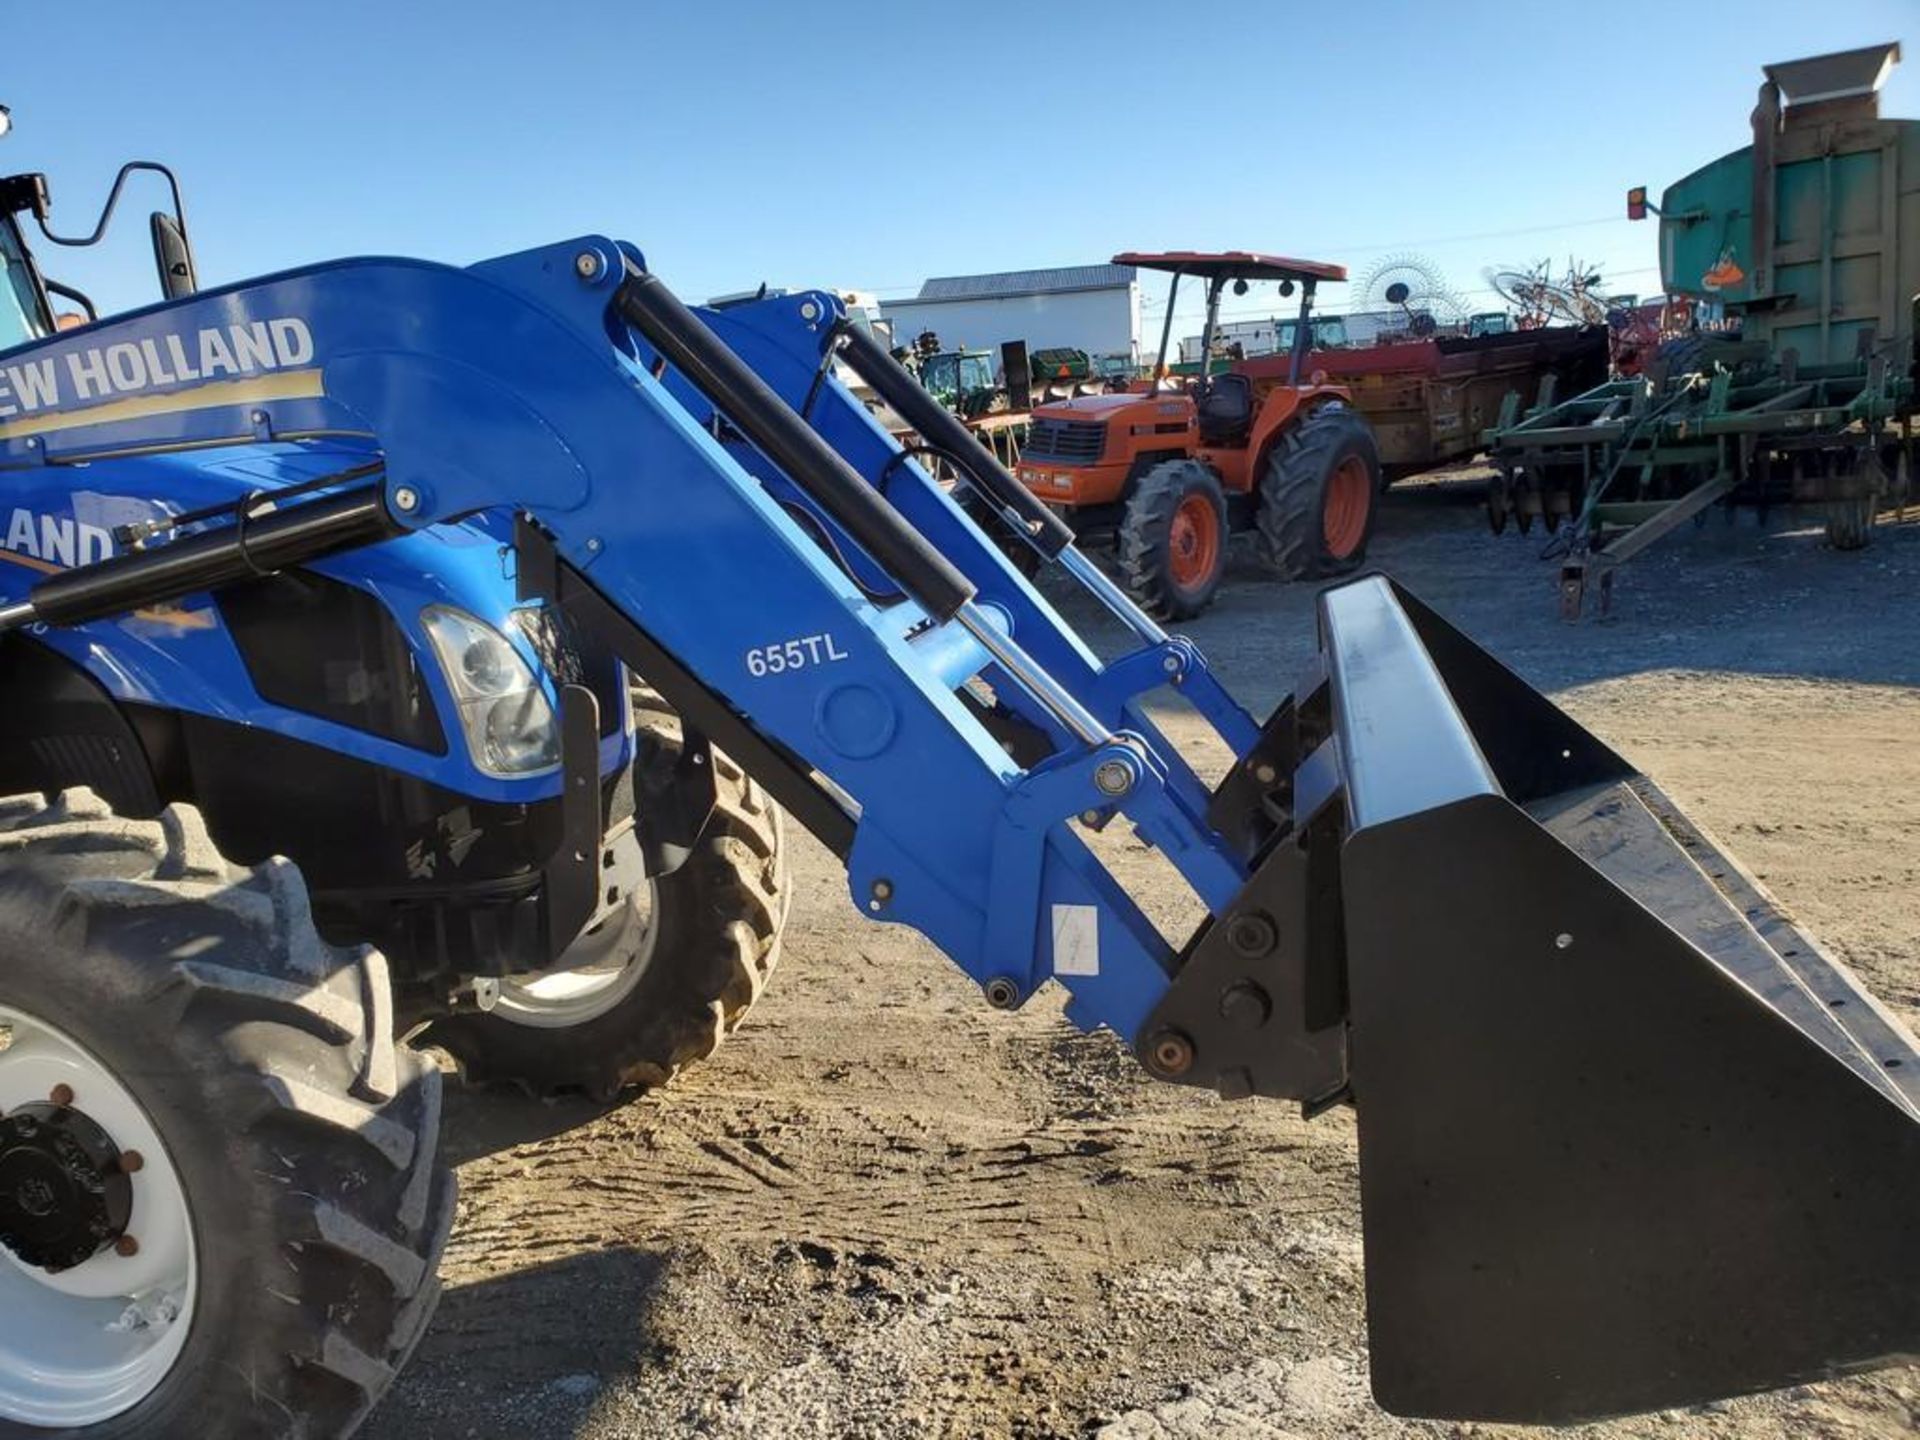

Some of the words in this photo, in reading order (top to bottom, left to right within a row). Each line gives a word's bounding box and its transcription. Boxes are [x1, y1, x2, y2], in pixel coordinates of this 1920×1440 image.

[65, 318, 314, 400] HOLLAND
[0, 507, 114, 568] AND
[746, 632, 848, 677] 655TL
